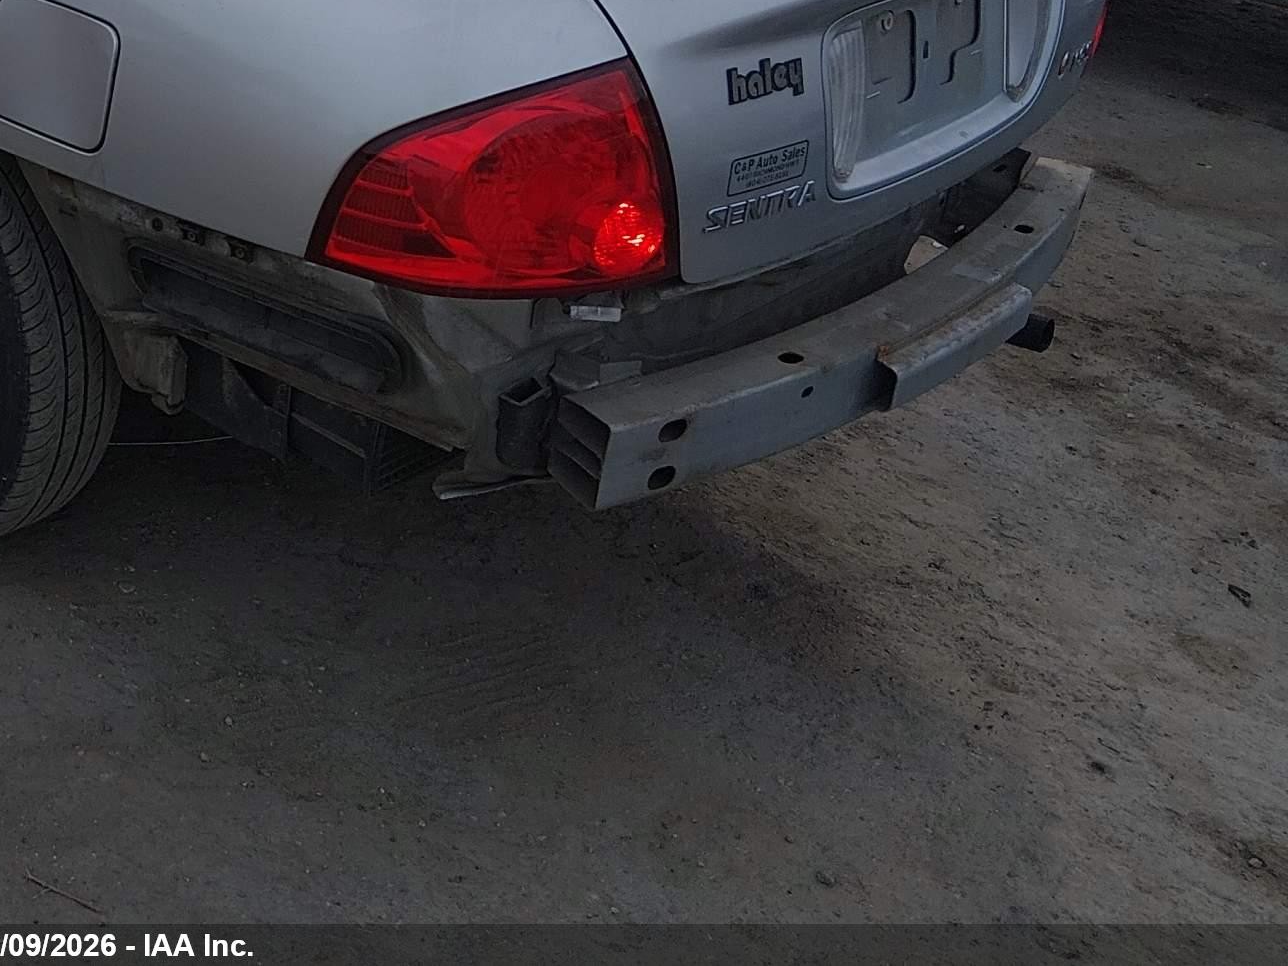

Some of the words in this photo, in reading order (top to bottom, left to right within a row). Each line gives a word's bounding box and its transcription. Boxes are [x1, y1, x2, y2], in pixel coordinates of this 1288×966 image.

[726, 57, 804, 106] haley
[734, 159, 755, 174] C&P
[756, 154, 778, 169] Auto
[781, 146, 806, 162] Sales
[702, 180, 816, 233] SENTRA
